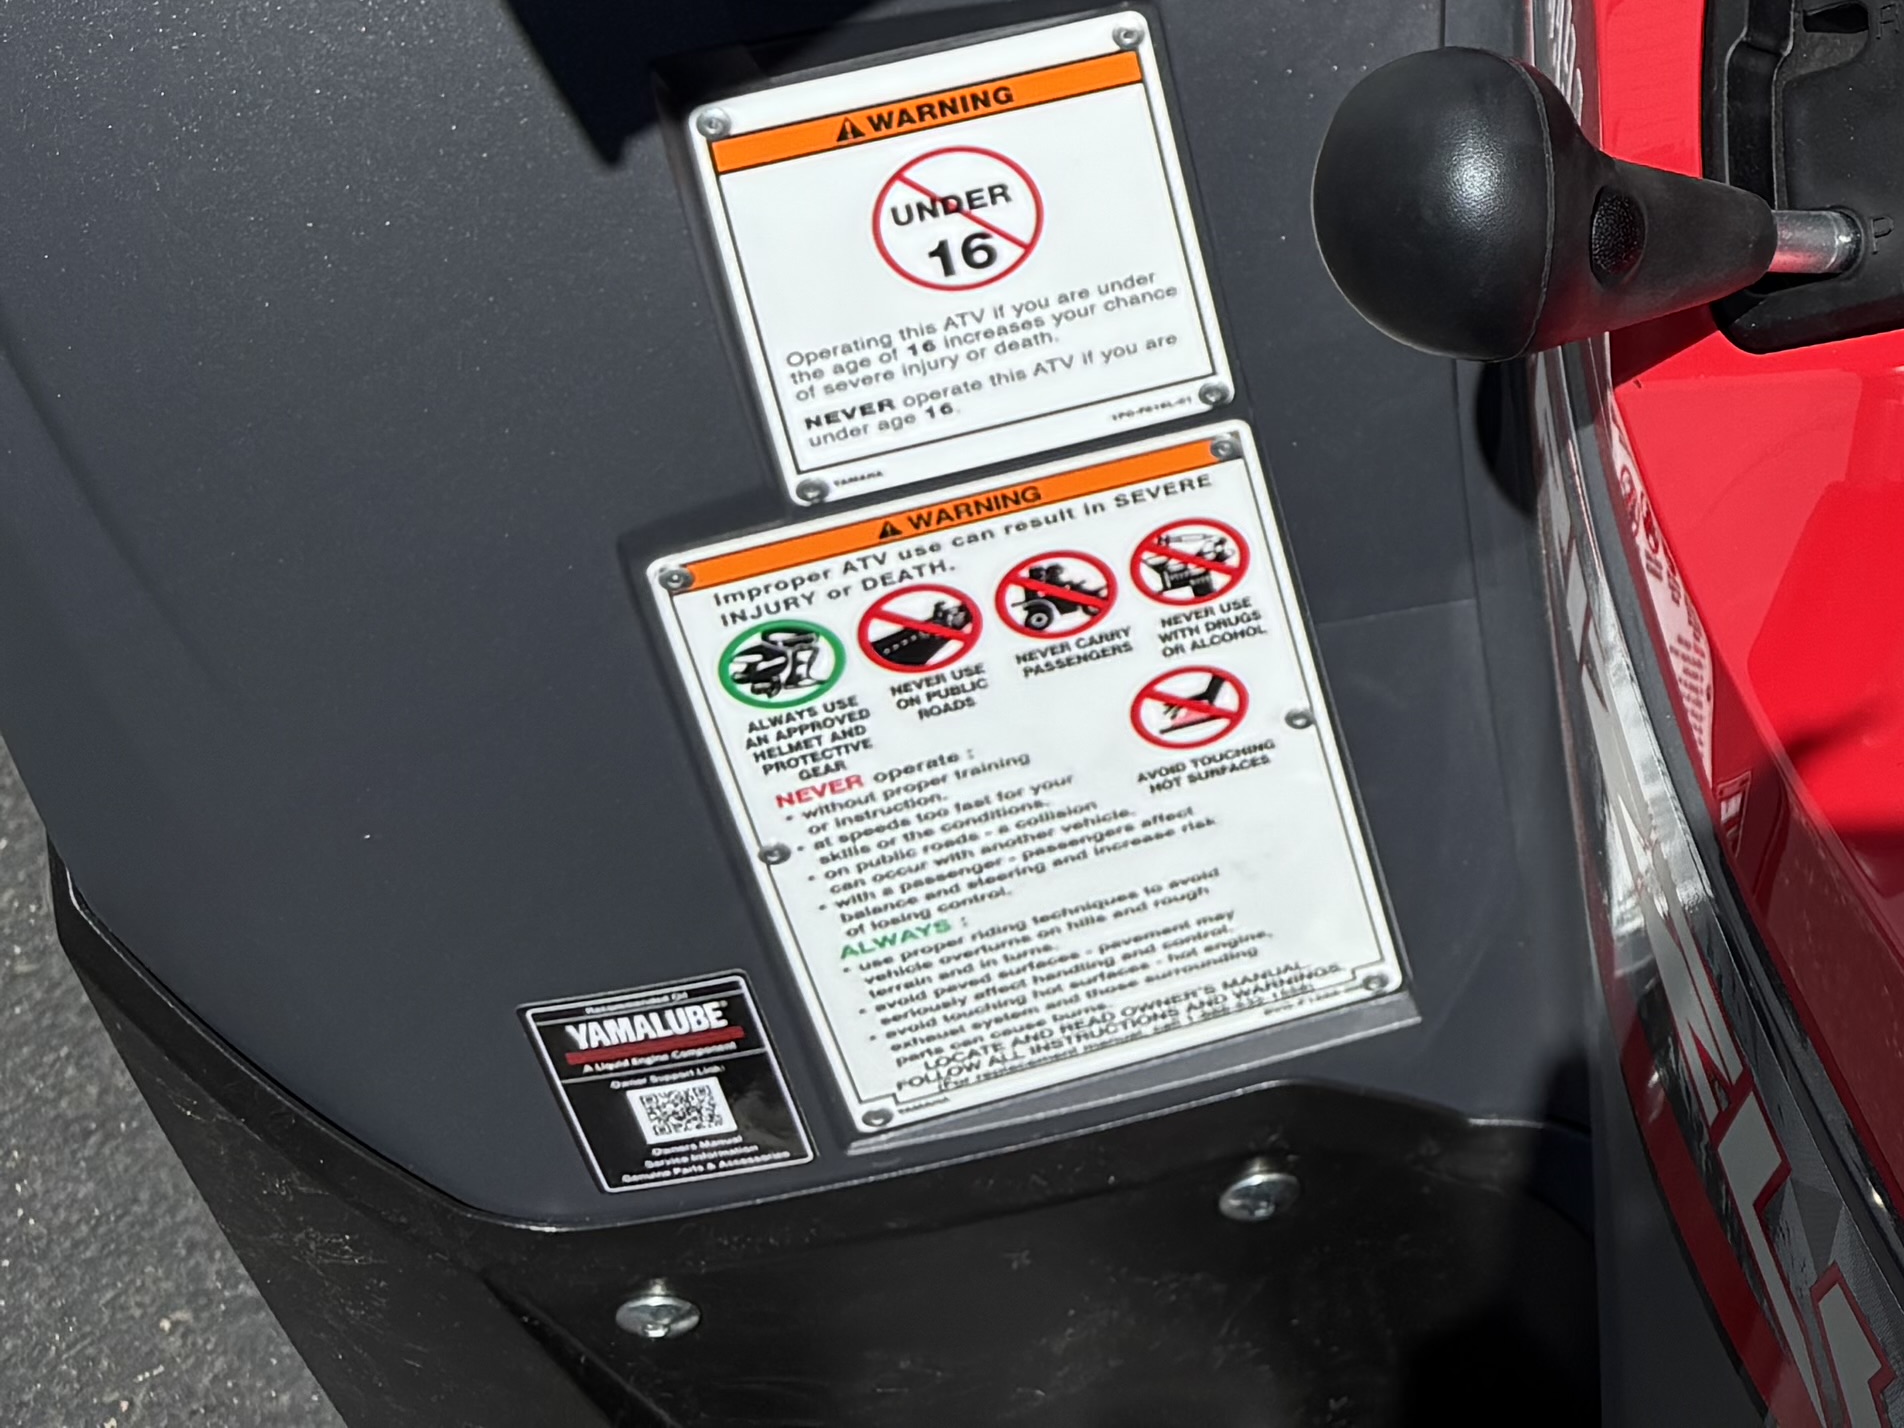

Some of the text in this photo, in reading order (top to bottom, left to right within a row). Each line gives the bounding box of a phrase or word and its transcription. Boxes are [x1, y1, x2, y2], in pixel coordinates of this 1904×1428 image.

[1875, 3, 1901, 40] R
[867, 86, 1013, 131] WARNING
[890, 183, 1010, 226] UNDER
[928, 228, 997, 276] 16
[1871, 216, 1895, 255] P
[785, 272, 1154, 367] Operating this ATV if you are under
[789, 286, 1177, 385] the age of 16 increases your chance
[794, 331, 1058, 402] of severe injury or death.
[804, 334, 1177, 430] NEVER operate this ATV if you are
[808, 423, 868, 447] under
[877, 413, 916, 431] age
[907, 485, 1041, 529] WARNING
[713, 473, 1210, 606] Improper ATV use can result in SEVERE
[720, 559, 954, 626] INJURY or DEATH.
[775, 774, 863, 808] NEVER
[840, 919, 951, 959] ALWAYS
[565, 1001, 729, 1050] YAMALUBE
